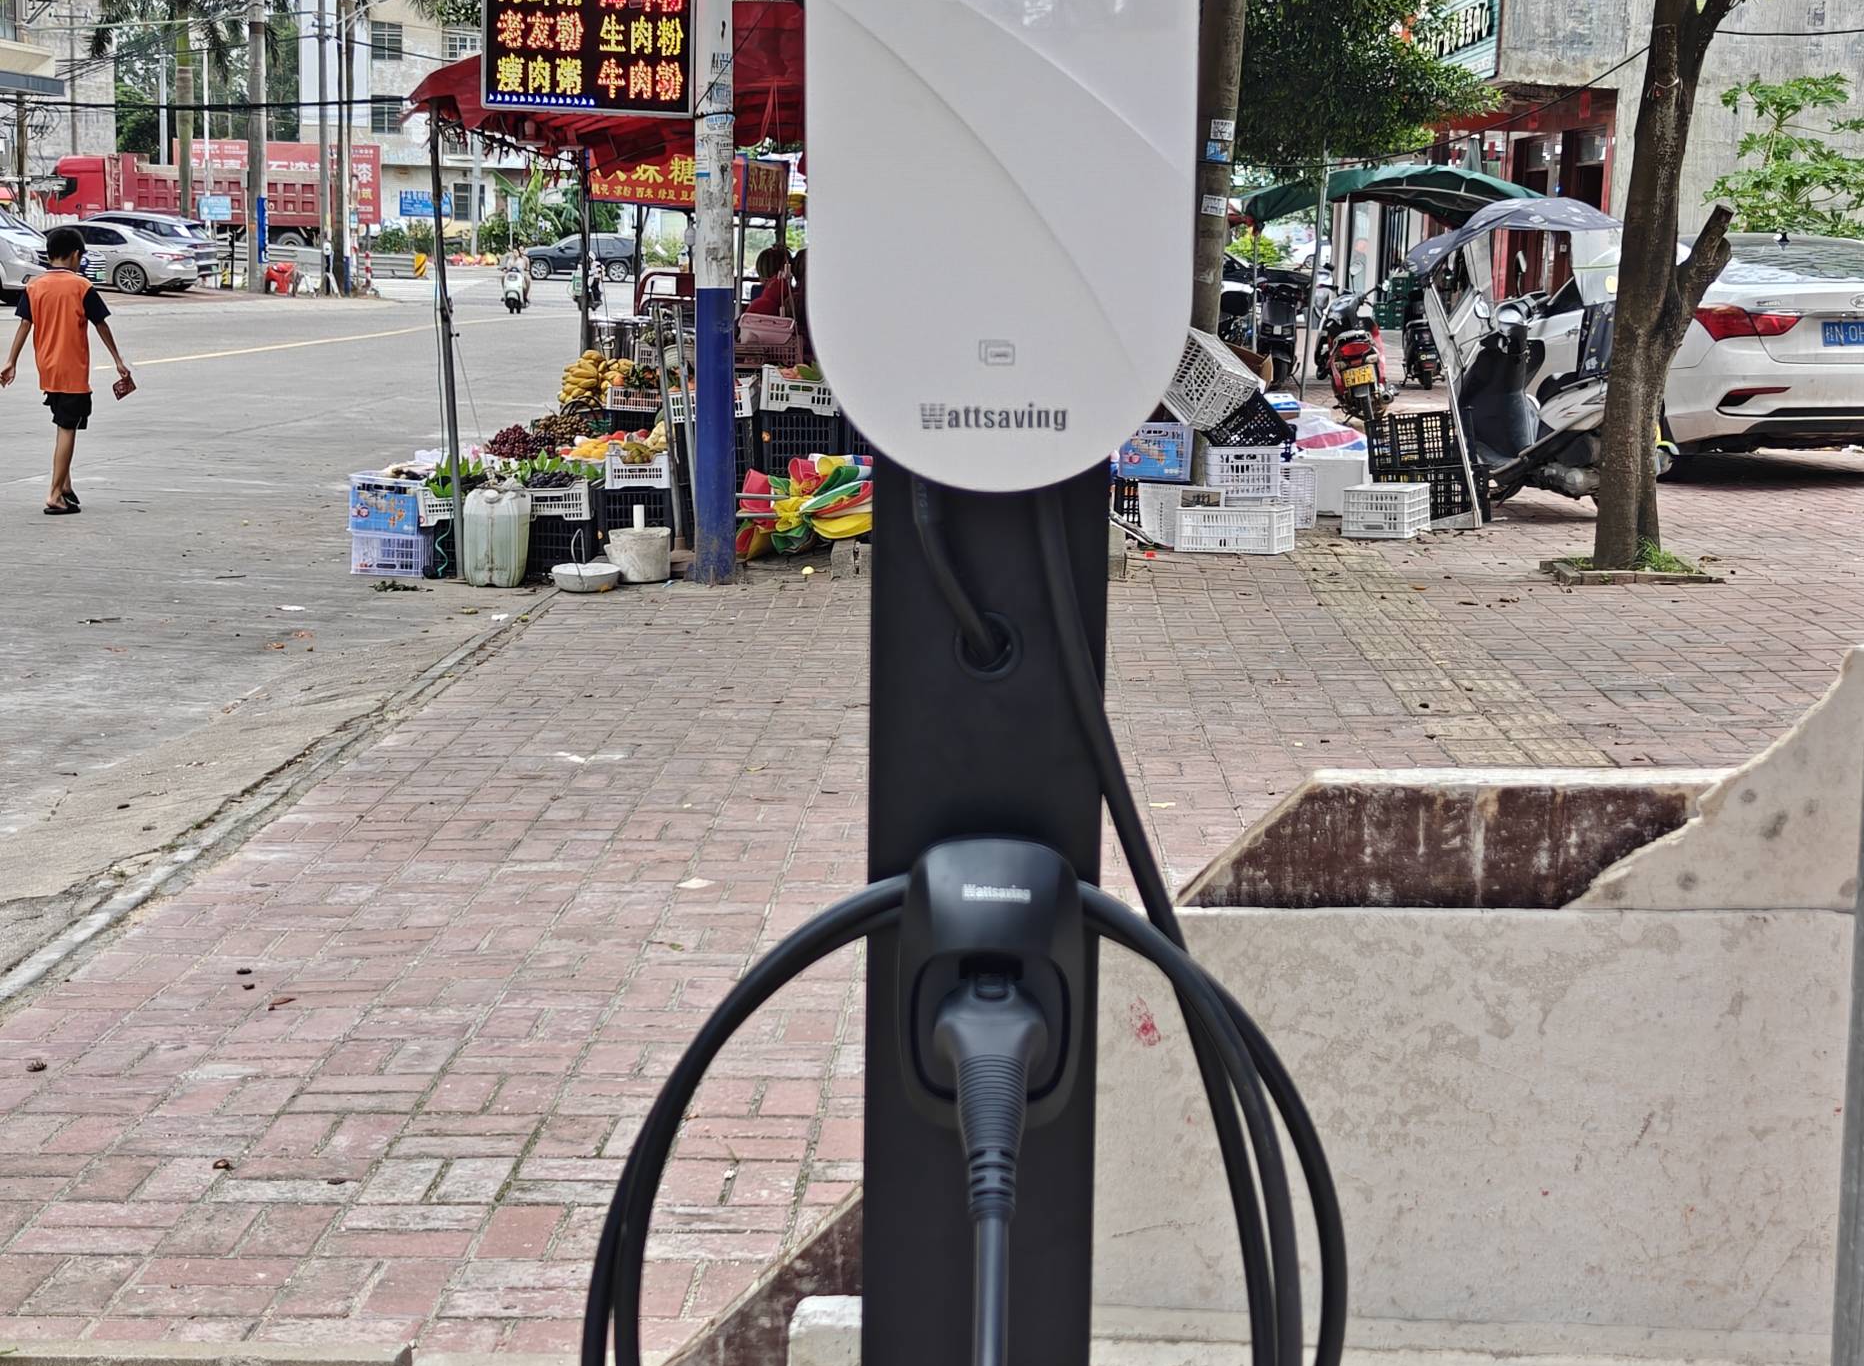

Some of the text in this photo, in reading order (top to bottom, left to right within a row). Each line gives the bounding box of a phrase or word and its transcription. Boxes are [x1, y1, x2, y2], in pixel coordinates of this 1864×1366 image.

[497, 9, 684, 56] 老友粉 生肉粉
[496, 53, 583, 95] 瘦肉粥
[598, 58, 684, 101] 牛肉粉
[920, 401, 1067, 431] Wattsaving
